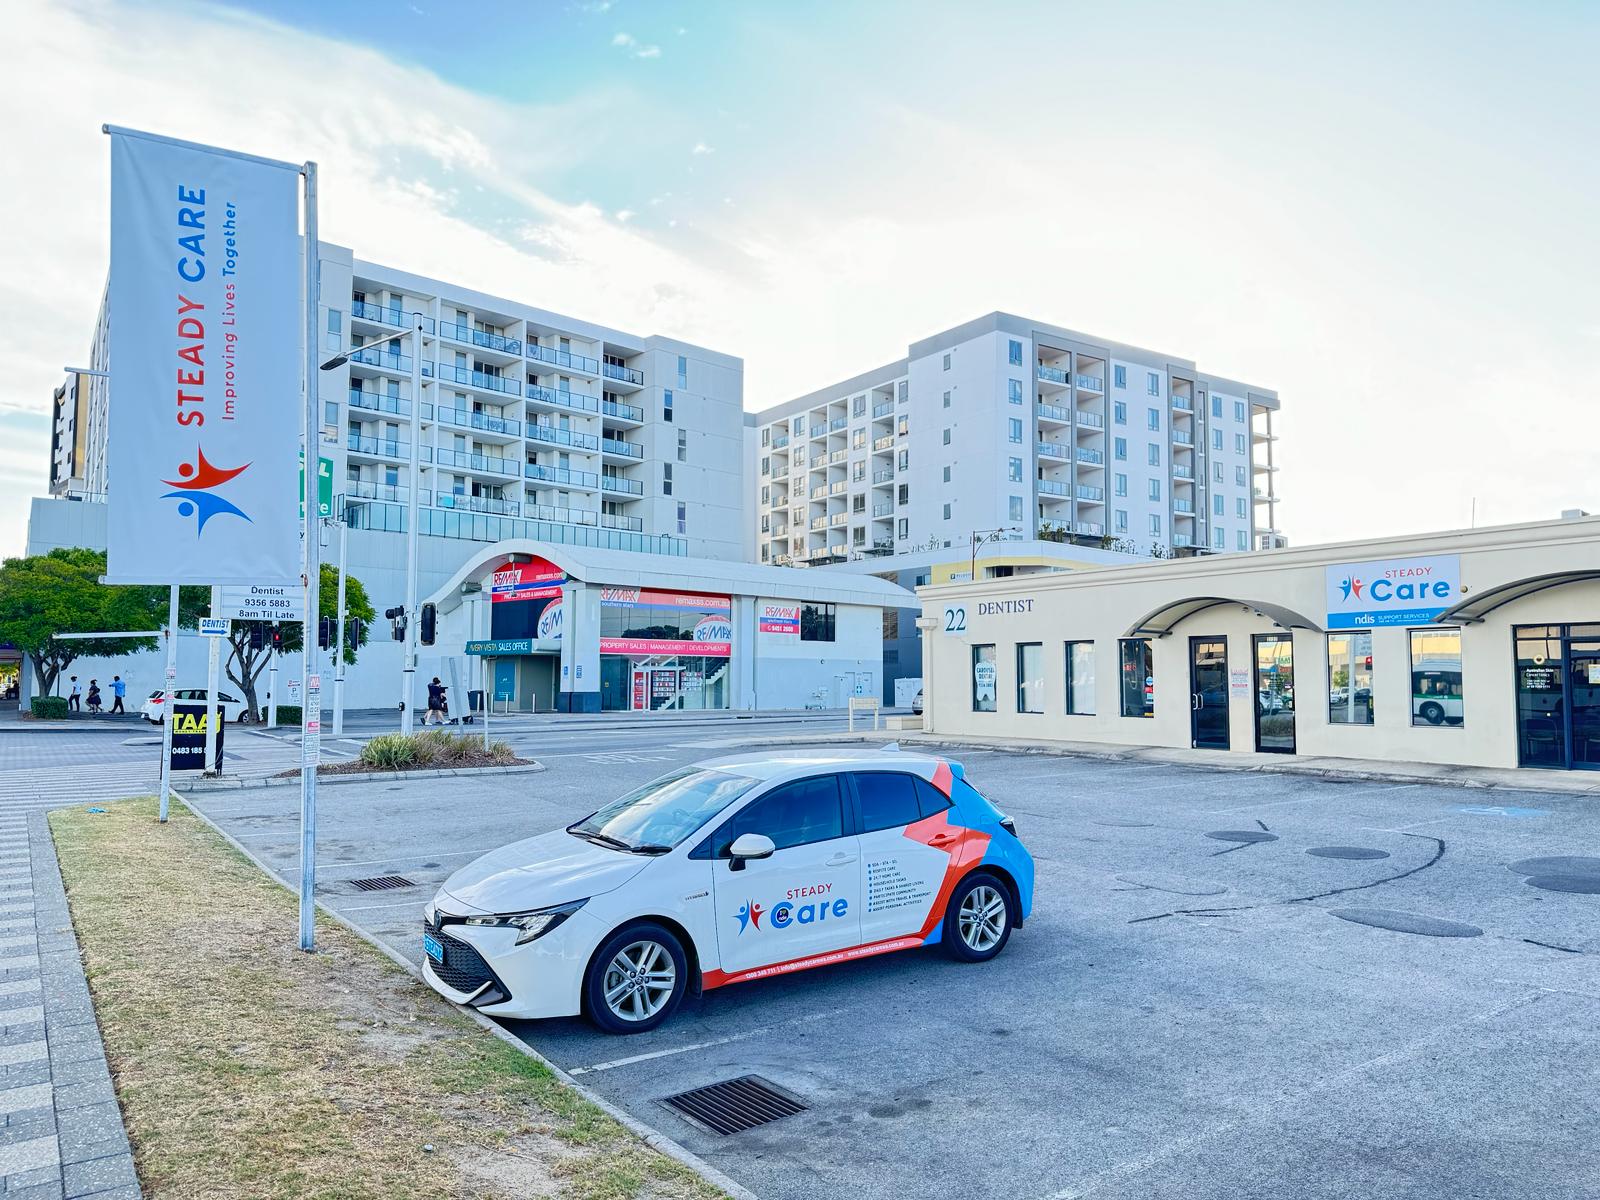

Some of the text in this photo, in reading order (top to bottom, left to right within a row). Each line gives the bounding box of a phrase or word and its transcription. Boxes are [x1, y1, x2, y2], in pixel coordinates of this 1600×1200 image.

[177, 185, 205, 427] STEADY CARE
[222, 202, 238, 420] Improving Lives Together
[1386, 567, 1432, 578] STEADY
[251, 586, 284, 595] Dentist
[600, 588, 637, 602] RE/MAX
[1370, 580, 1450, 601] Care
[270, 600, 290, 608] 5883
[978, 599, 1034, 615] DENTIST
[239, 610, 258, 618] 8am
[766, 606, 793, 618] RE/MAX
[202, 620, 230, 628] DENTIST
[946, 608, 966, 632] 22
[1355, 614, 1375, 624] ndis
[499, 643, 511, 651] SALES
[512, 642, 528, 650] OFFICE
[650, 643, 686, 651] MANAGEMENT
[787, 883, 832, 899] STEADY
[770, 899, 848, 929] Care
